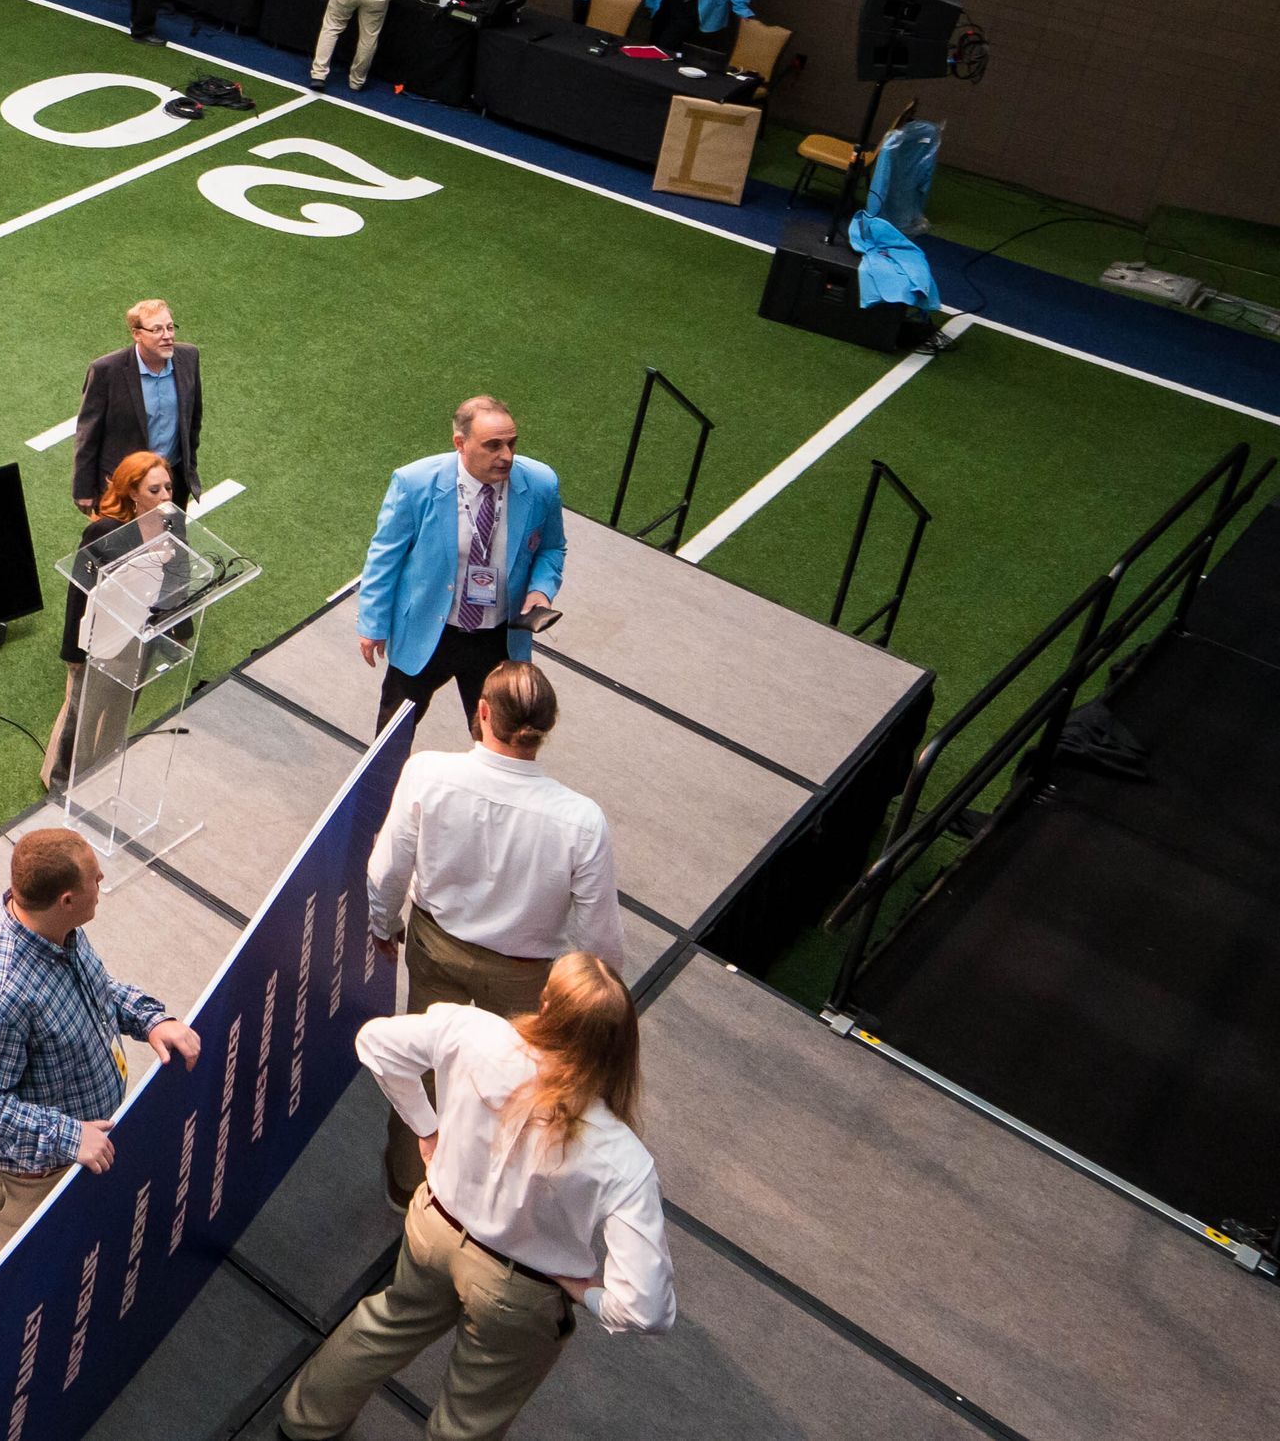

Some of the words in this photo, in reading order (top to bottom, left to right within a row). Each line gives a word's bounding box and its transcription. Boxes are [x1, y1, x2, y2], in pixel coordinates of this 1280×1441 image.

[293, 890, 317, 1051] CASTLEBERRY
[333, 889, 349, 967] CURRY
[258, 968, 279, 1069] BROOKS
[208, 1108, 231, 1221] EMERSON
[222, 1012, 242, 1112] BOOZER
[251, 1064, 269, 1143] JAMES
[176, 1110, 198, 1207] BLOUNT
[128, 1179, 152, 1264] BERRY
[168, 1200, 186, 1257] MEL
[75, 1240, 101, 1326] BELUE
[118, 1258, 140, 1320] ERIC
[14, 1302, 44, 1395] BAILEY
[62, 1318, 89, 1393] BUCK
[6, 1393, 30, 1441] AMP
